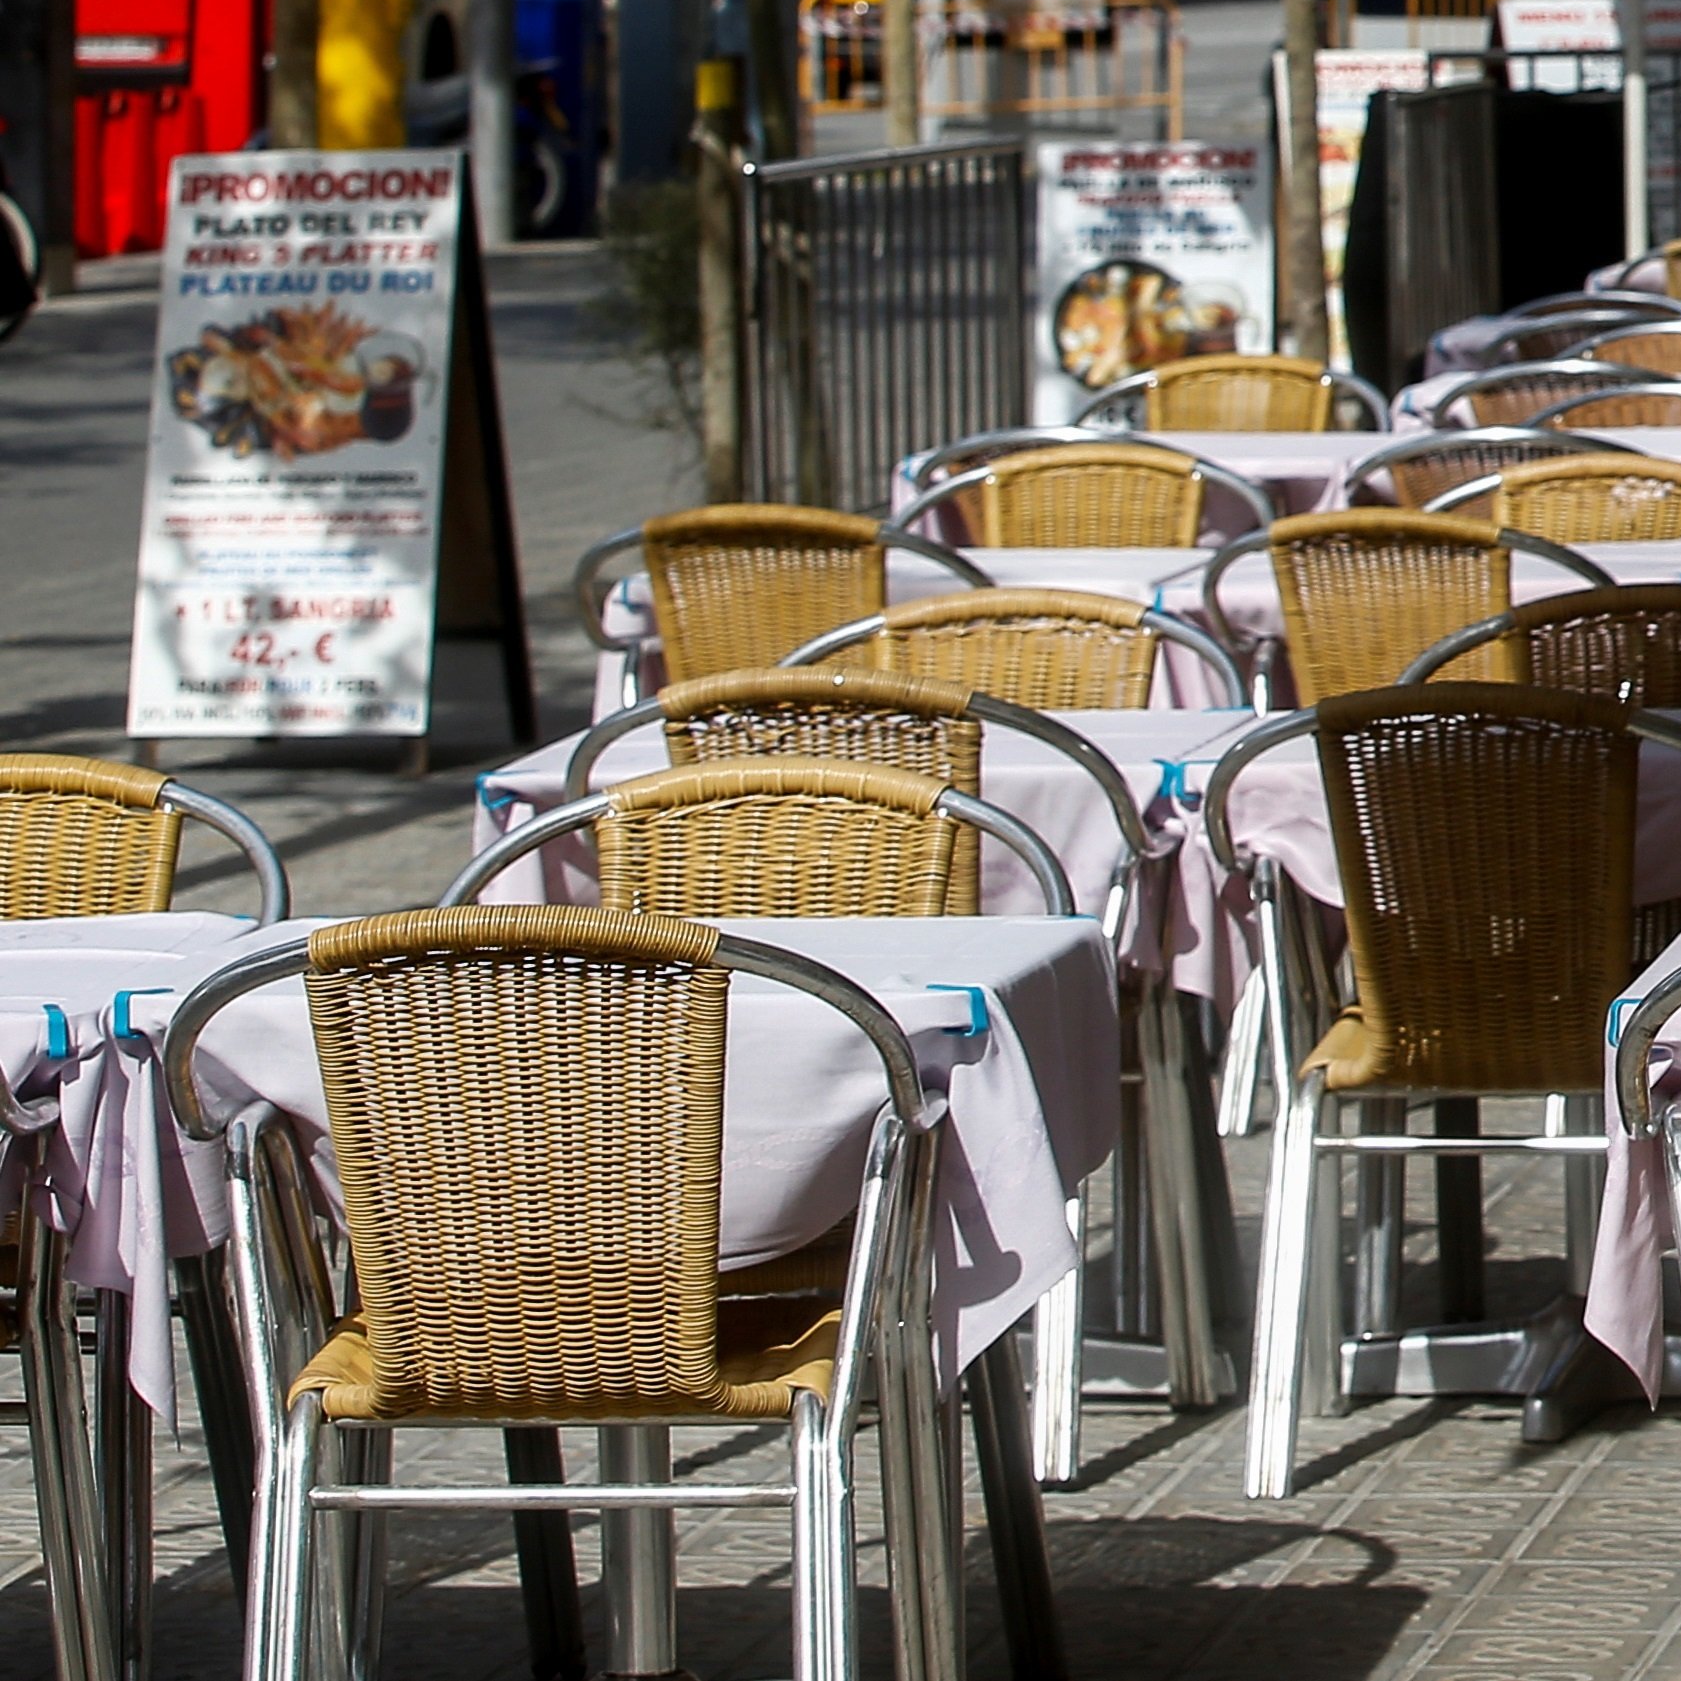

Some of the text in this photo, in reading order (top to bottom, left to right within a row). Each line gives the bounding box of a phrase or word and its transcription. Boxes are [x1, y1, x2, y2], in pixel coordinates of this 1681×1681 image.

[193, 212, 291, 237] PLATO
[300, 212, 358, 236] DEL
[179, 269, 435, 298] PLATEAU DU ROI
